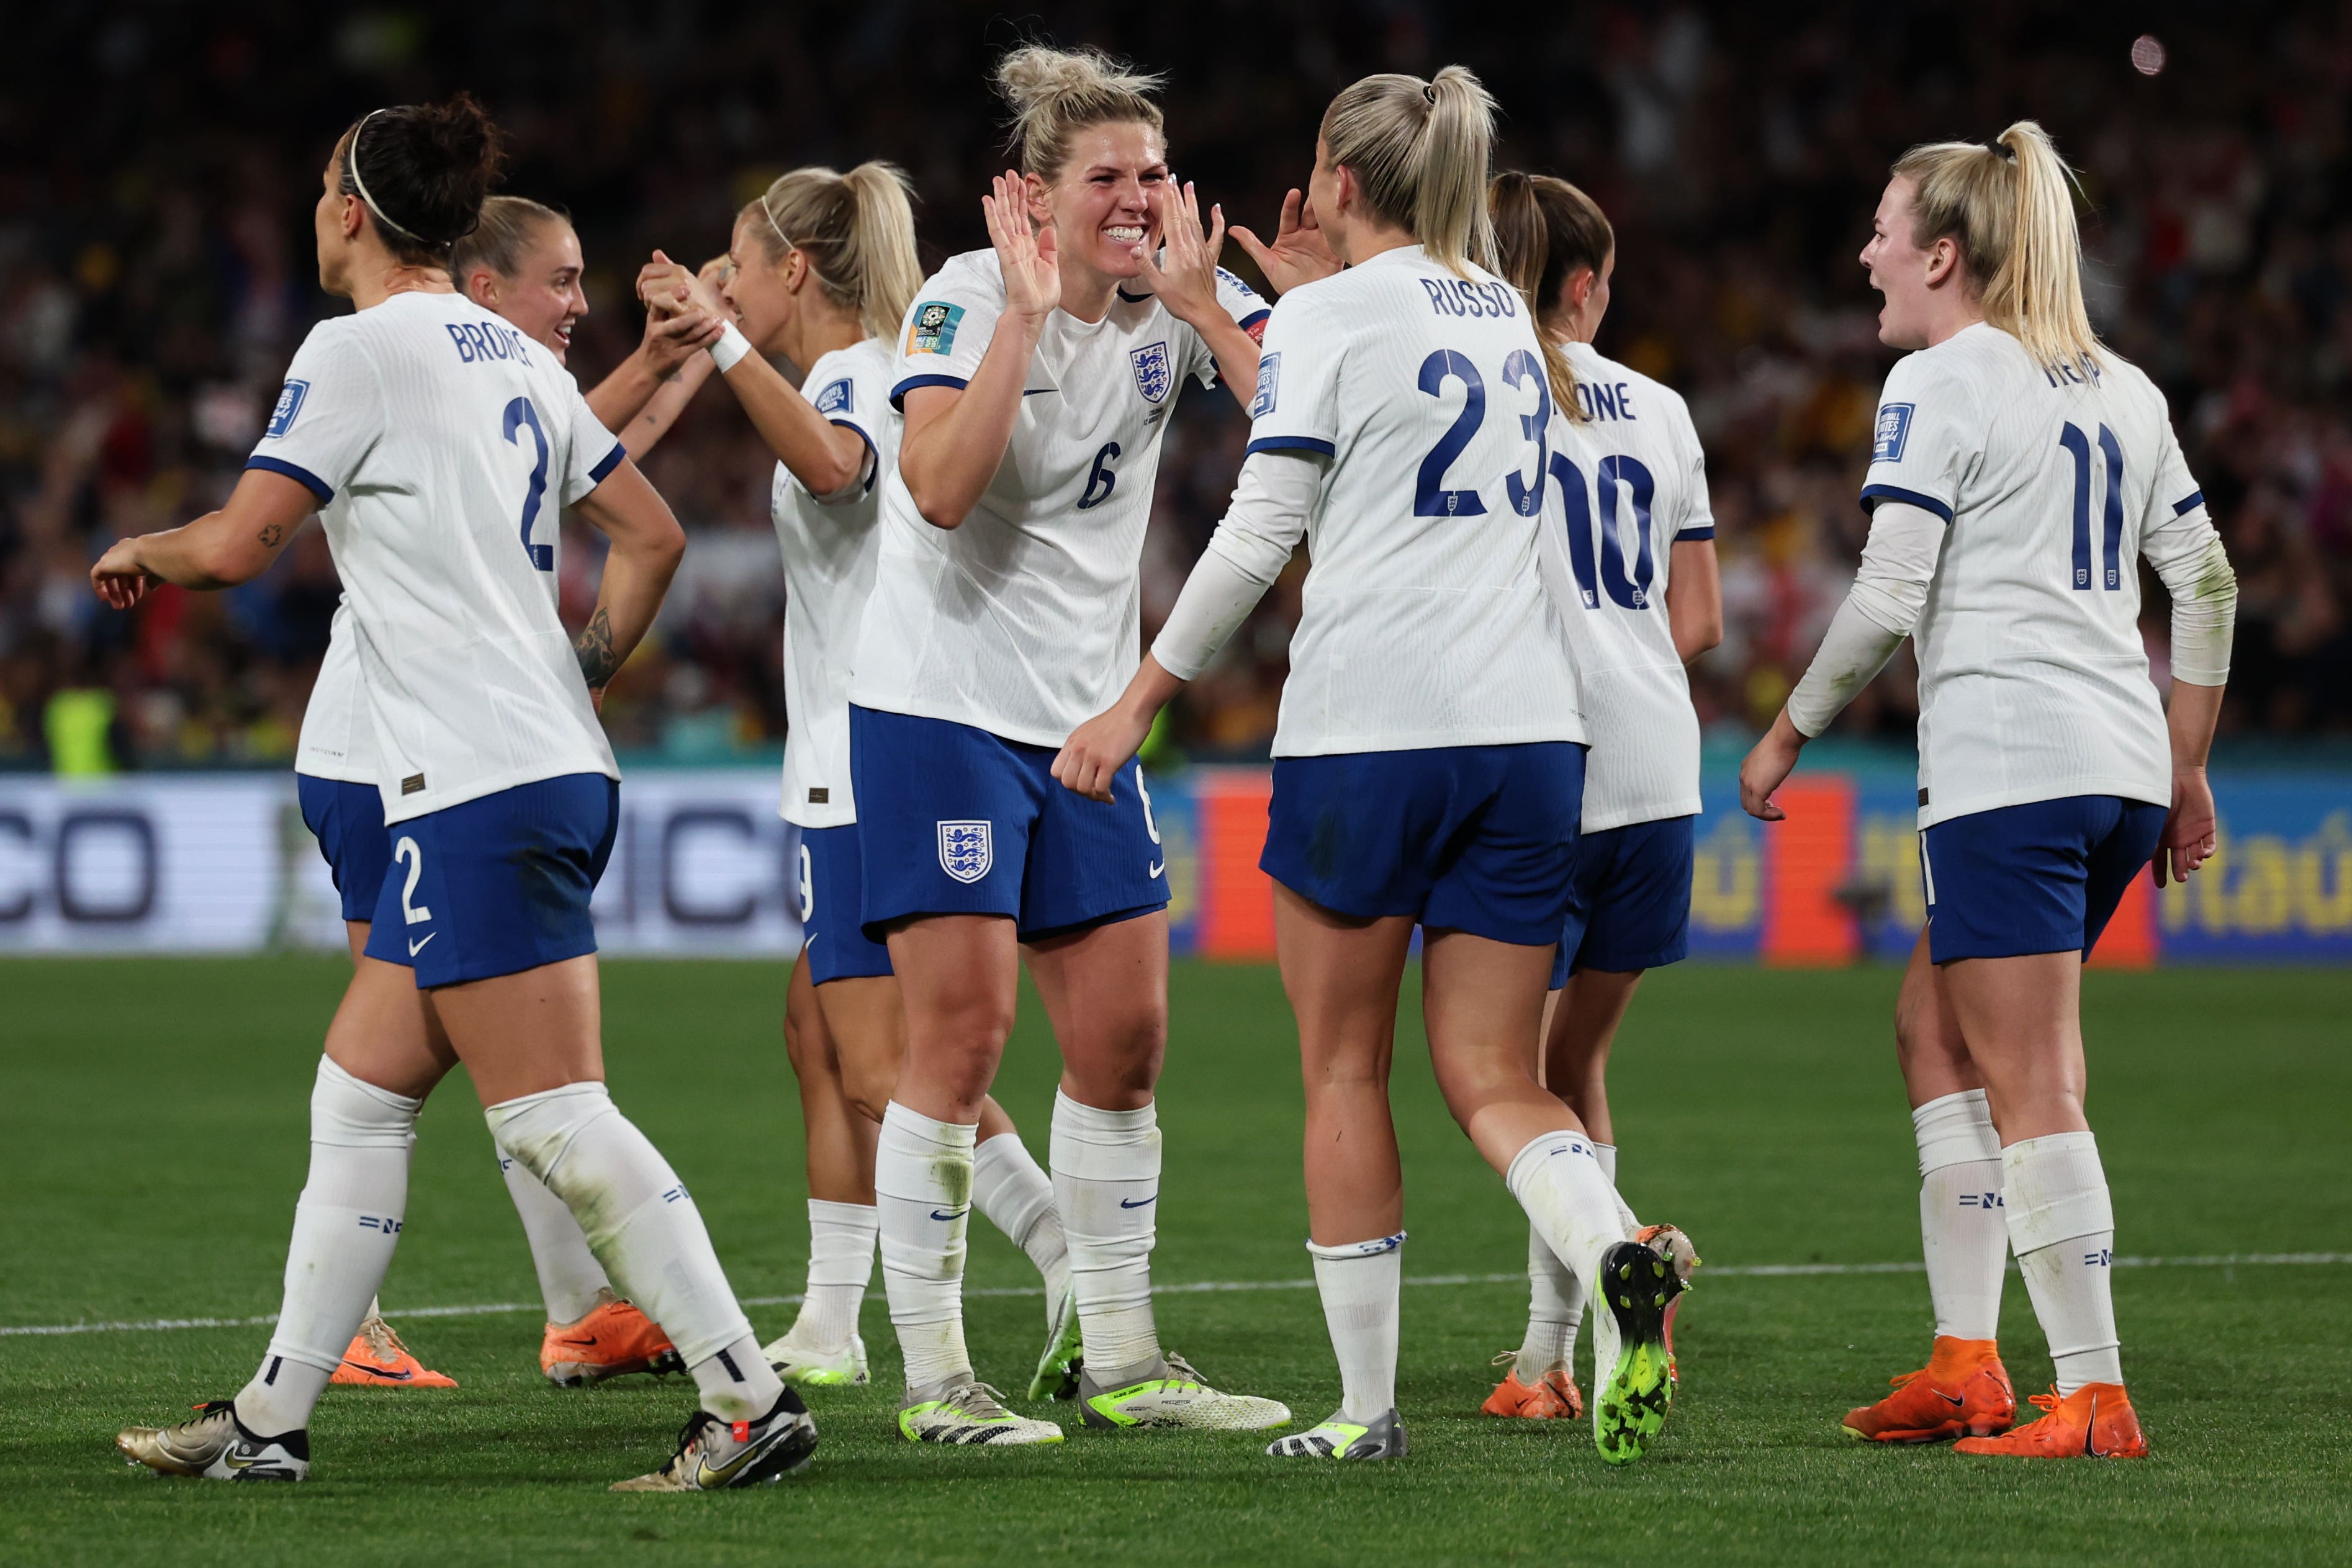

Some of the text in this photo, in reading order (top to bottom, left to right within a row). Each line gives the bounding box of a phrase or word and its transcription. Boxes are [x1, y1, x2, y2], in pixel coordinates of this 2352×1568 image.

[1419, 278, 1515, 318] RUSSO
[503, 396, 554, 572] 2
[1077, 441, 1121, 510] 6
[1413, 349, 1551, 518] 23
[2059, 421, 2124, 590] 11
[1548, 450, 1655, 610] 10
[395, 836, 432, 926] 2
